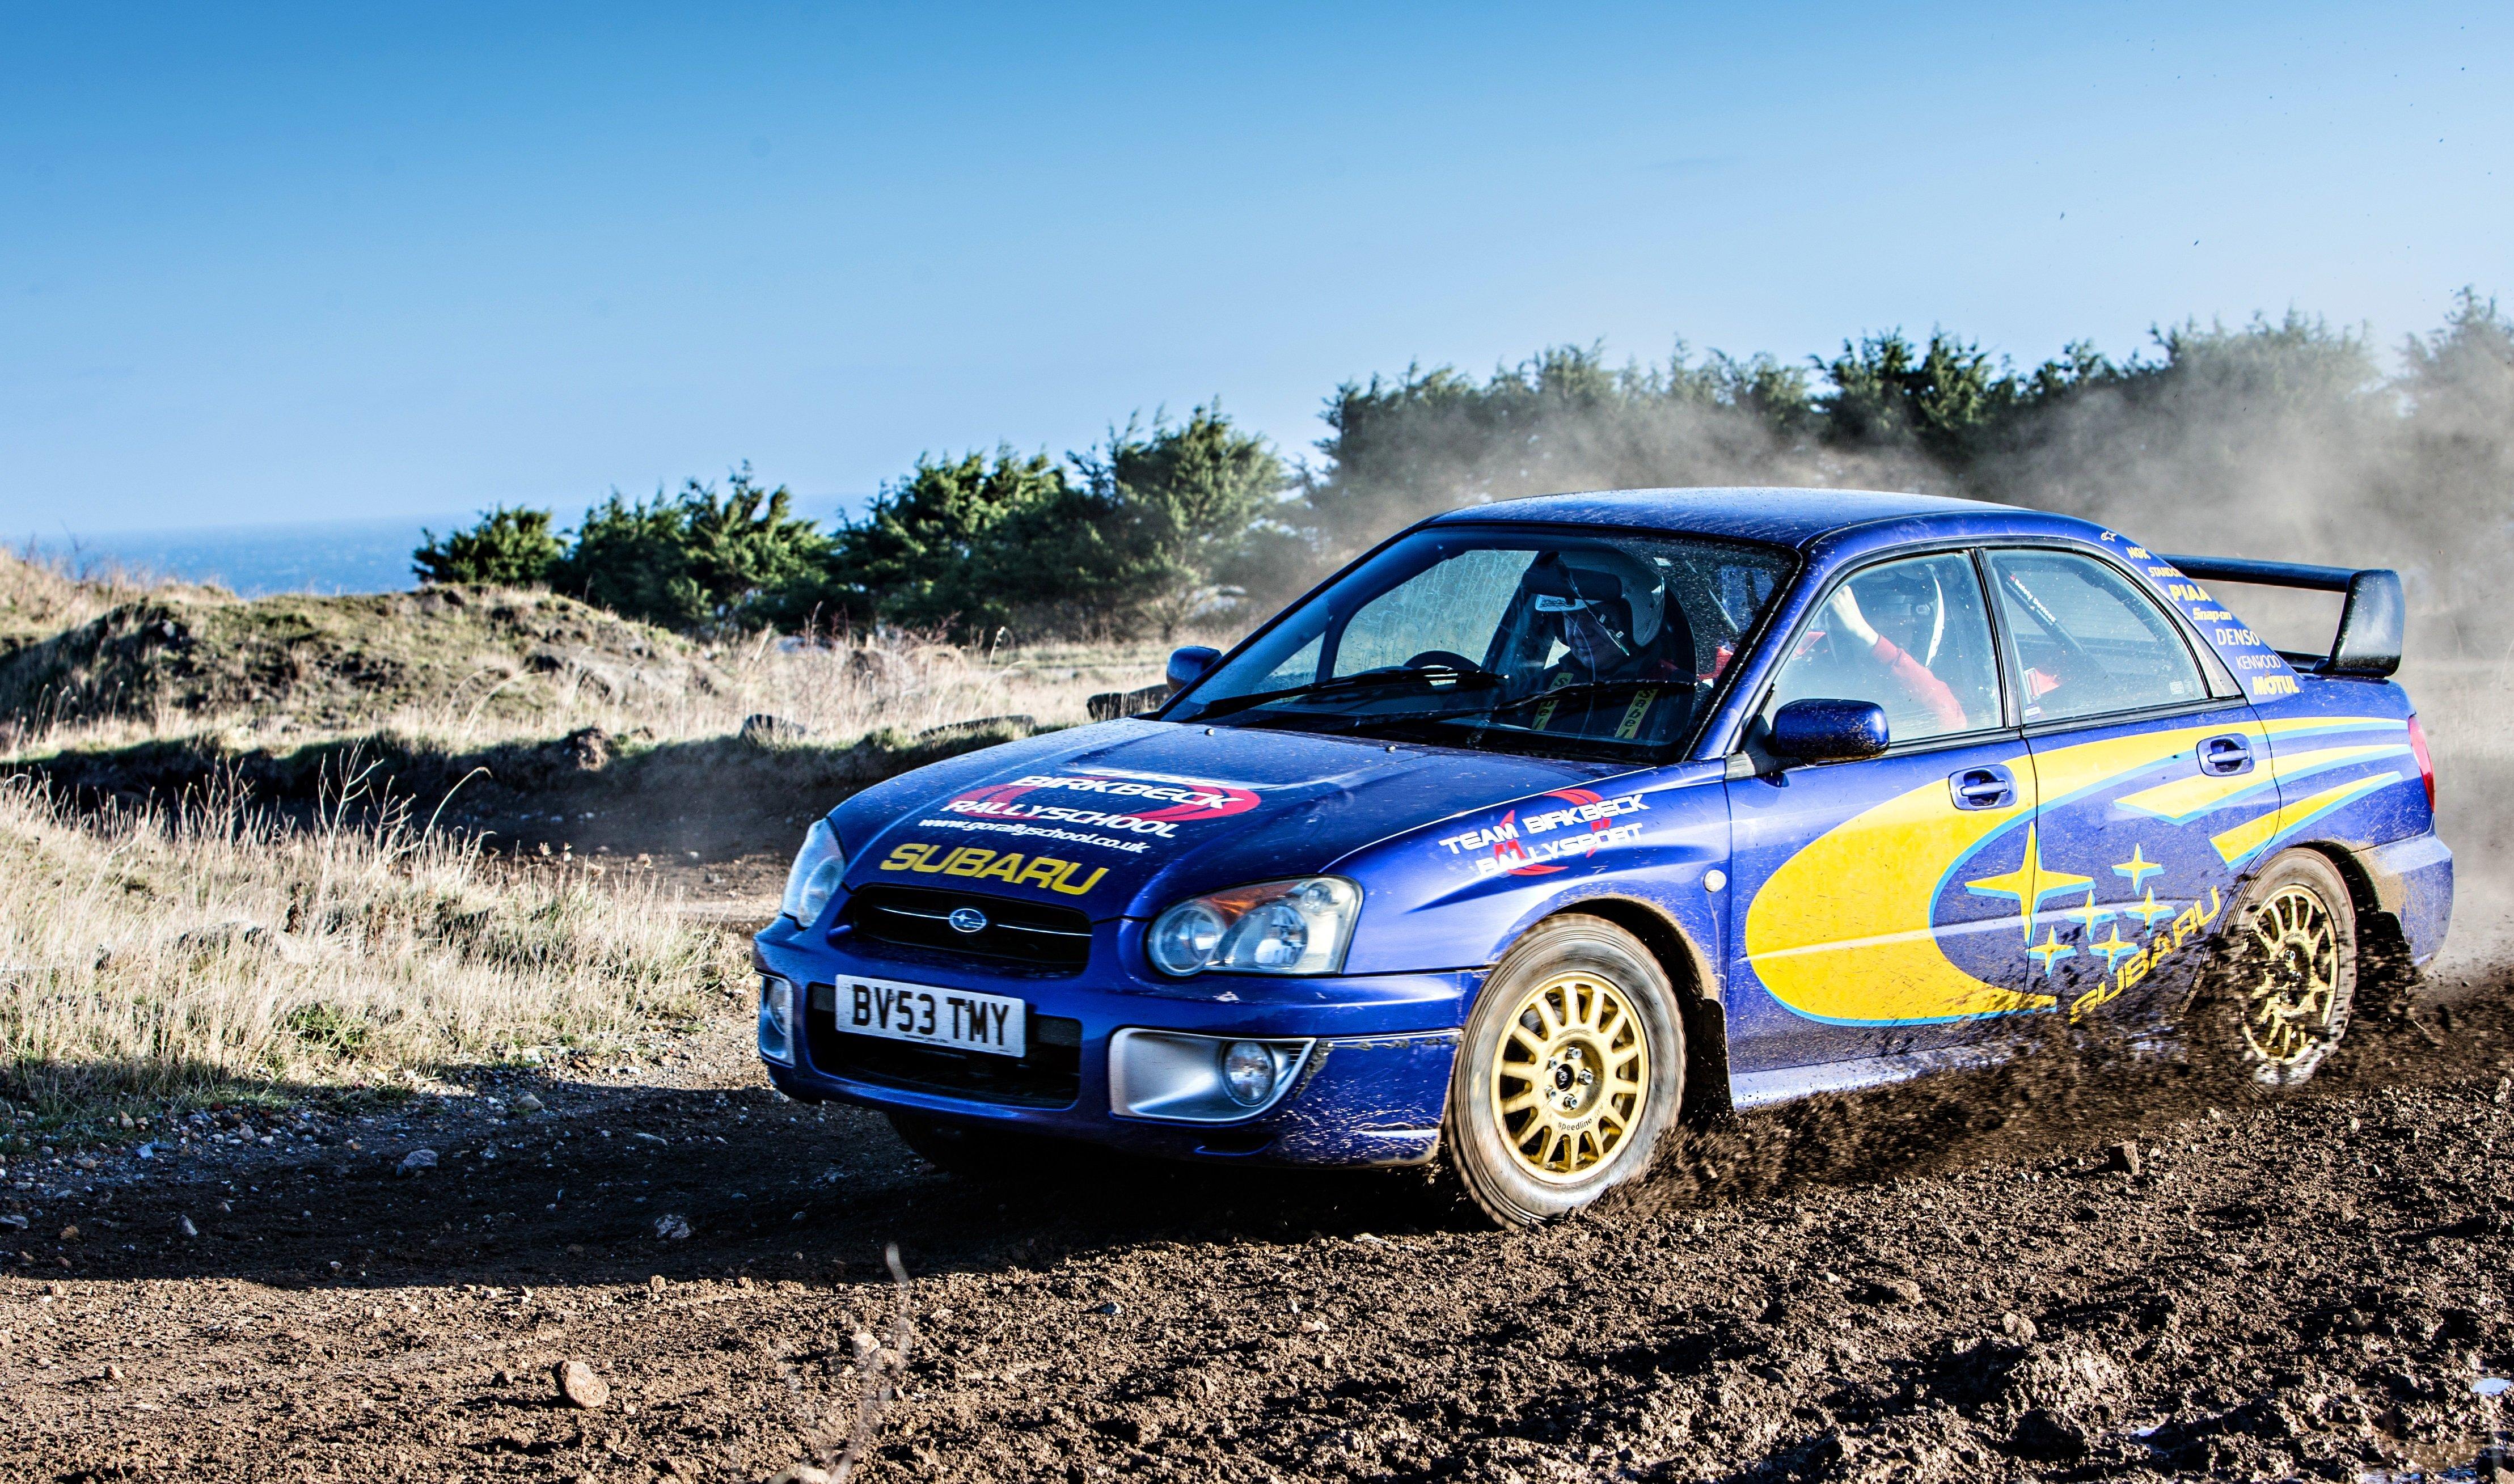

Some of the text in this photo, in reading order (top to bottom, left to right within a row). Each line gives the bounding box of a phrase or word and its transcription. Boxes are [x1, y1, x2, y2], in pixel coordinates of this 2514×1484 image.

[2169, 585, 2212, 601] PIAA
[2192, 607, 2232, 622] Snap-on
[2215, 628, 2260, 646] DENSO
[2236, 654, 2281, 670] KENWOOD
[2251, 675, 2300, 695] MOTUL
[1008, 775, 1245, 809] BIRKBECK
[918, 819, 1151, 853] www.gorallyschool.co.uk
[940, 800, 1180, 838] RALLYSCHOOL
[1438, 794, 1650, 855] TEAM BIRKBECK
[1475, 822, 1643, 876] RALLYSPORT
[880, 843, 1110, 895] SUBARU
[2069, 885, 2220, 1024] SUBARU
[852, 984, 1010, 1046] BV53 TMY
[1557, 1118, 1592, 1131] speedline
